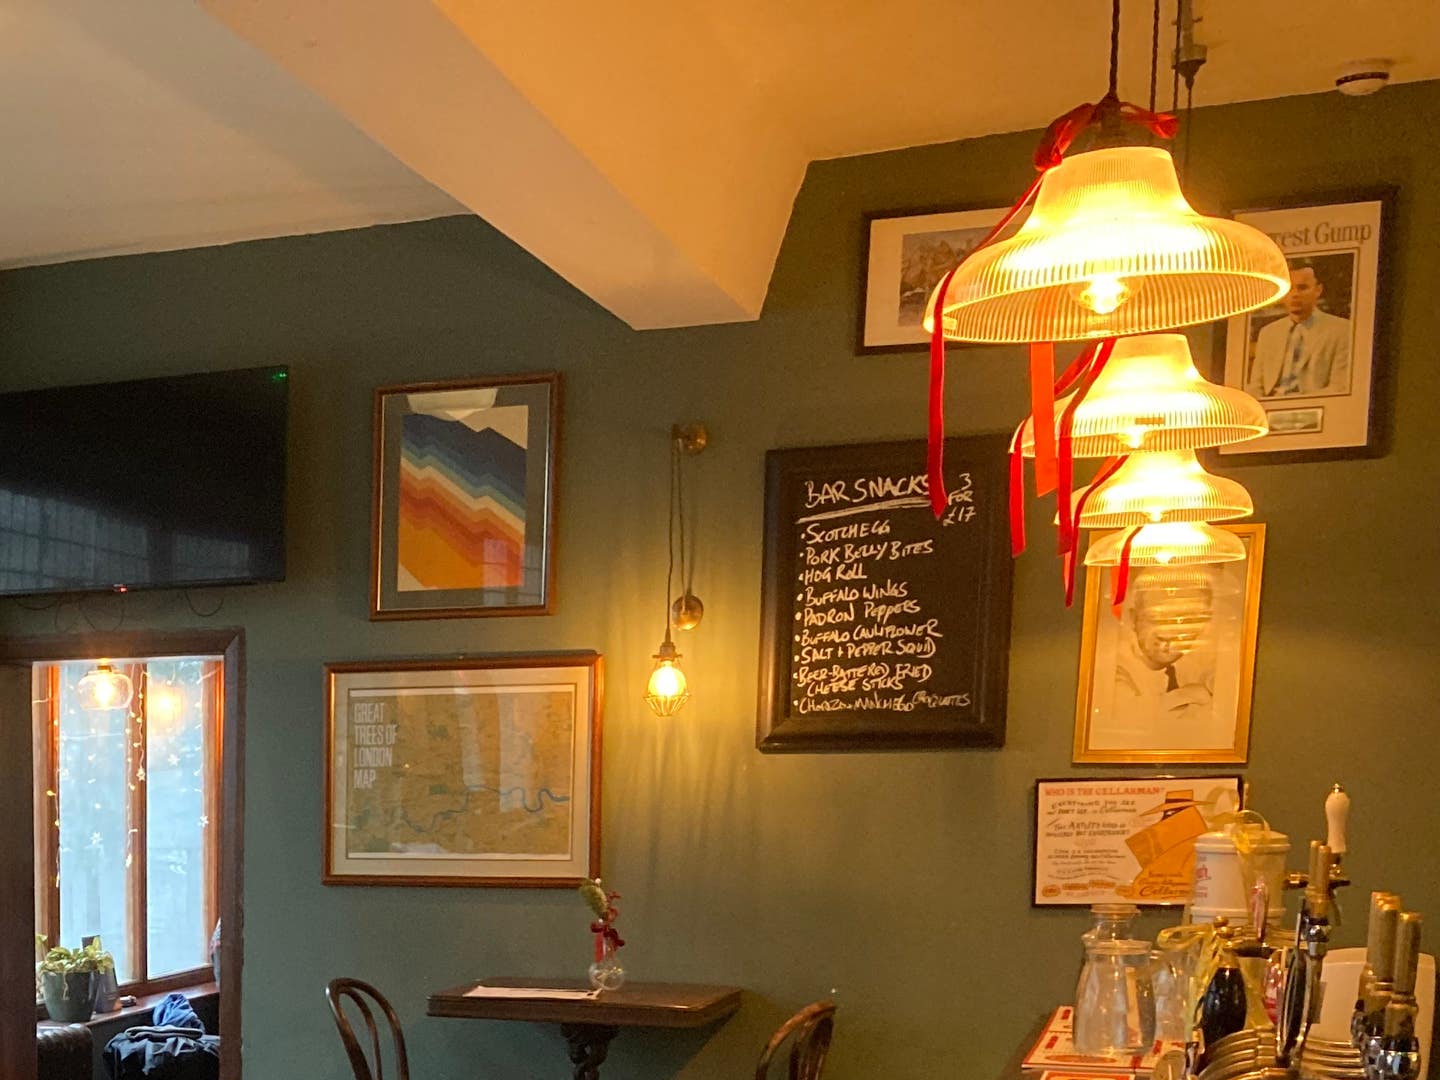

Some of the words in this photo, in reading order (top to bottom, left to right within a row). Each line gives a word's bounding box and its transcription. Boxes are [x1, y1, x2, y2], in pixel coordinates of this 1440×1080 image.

[1314, 222, 1372, 245] Gump
[959, 473, 972, 490] 3
[805, 480, 850, 508] BAR
[947, 489, 973, 506] FOR
[943, 506, 977, 527] £17
[806, 523, 858, 545] SCOTCH
[806, 546, 841, 565] PORK
[844, 541, 888, 563] BELLY
[889, 539, 933, 560] BITES
[805, 566, 832, 586] HOG
[836, 563, 868, 580] ROLL
[805, 586, 859, 607] BUFFALO
[862, 578, 908, 599] WINGS
[804, 602, 854, 627] PADRON
[801, 629, 850, 647] BUFFALO
[853, 618, 943, 641] CAULIFLOWER
[801, 647, 834, 664] SALT
[846, 641, 894, 659] PEPPER
[895, 636, 936, 658] SQUID
[896, 664, 932, 683] FRIED
[807, 679, 857, 697] CHEESE
[862, 676, 903, 691] STICKS
[354, 703, 384, 723] GREAT
[354, 724, 384, 745] TREES
[385, 724, 398, 745] OF
[354, 747, 393, 767] LONDON
[354, 769, 376, 789] MAP
